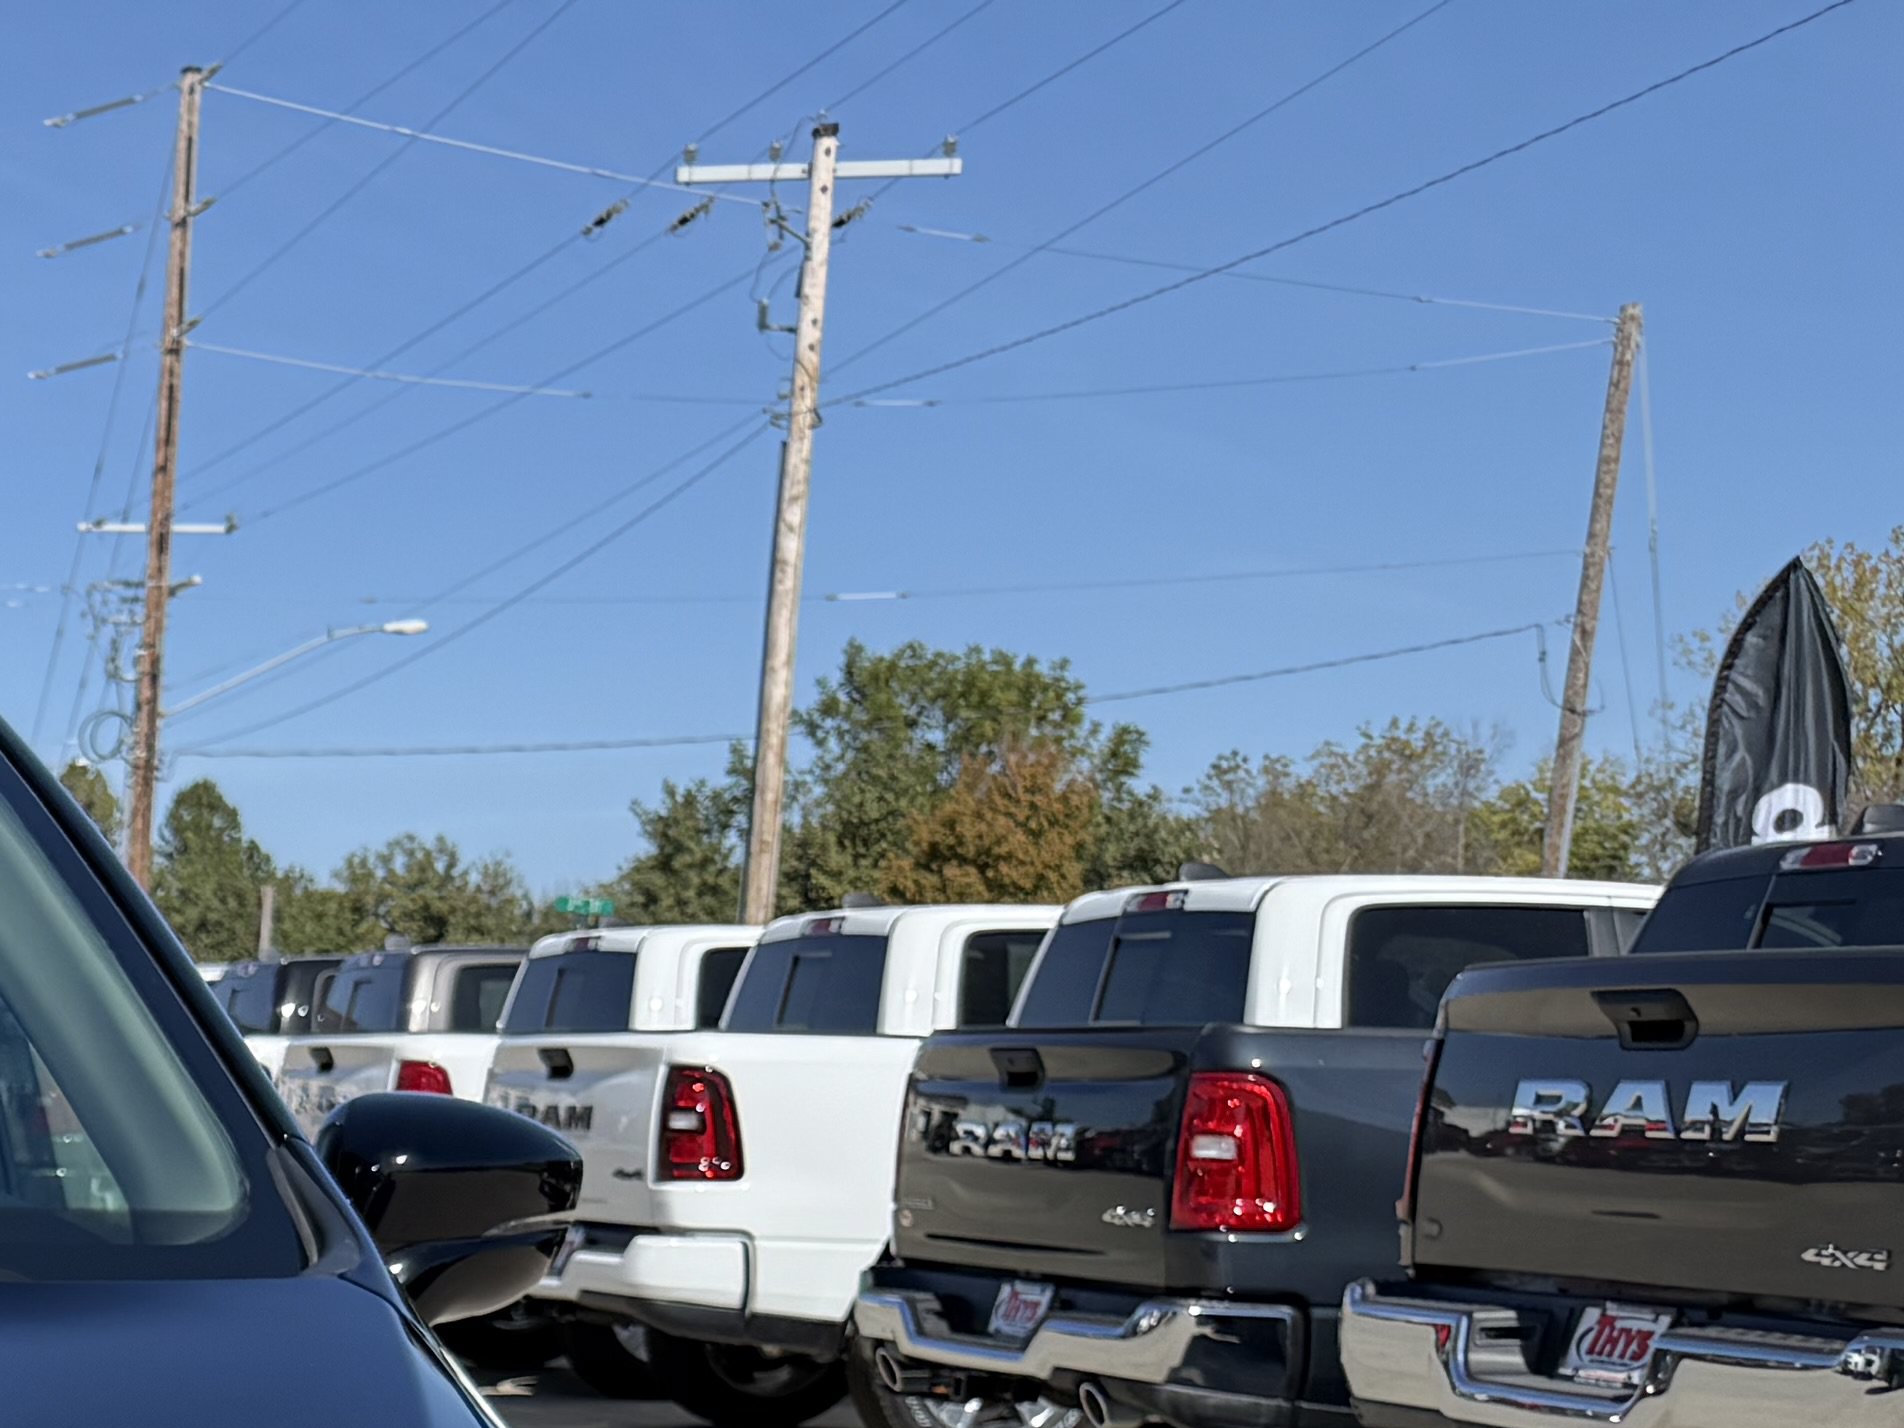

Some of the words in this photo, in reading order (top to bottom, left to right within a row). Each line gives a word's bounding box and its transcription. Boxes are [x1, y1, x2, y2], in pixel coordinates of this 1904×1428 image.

[1508, 1078, 1789, 1143] RAM
[948, 1121, 1077, 1162] RAM
[1800, 1244, 1889, 1272] 4x4
[1584, 1313, 1656, 1362] THYS
